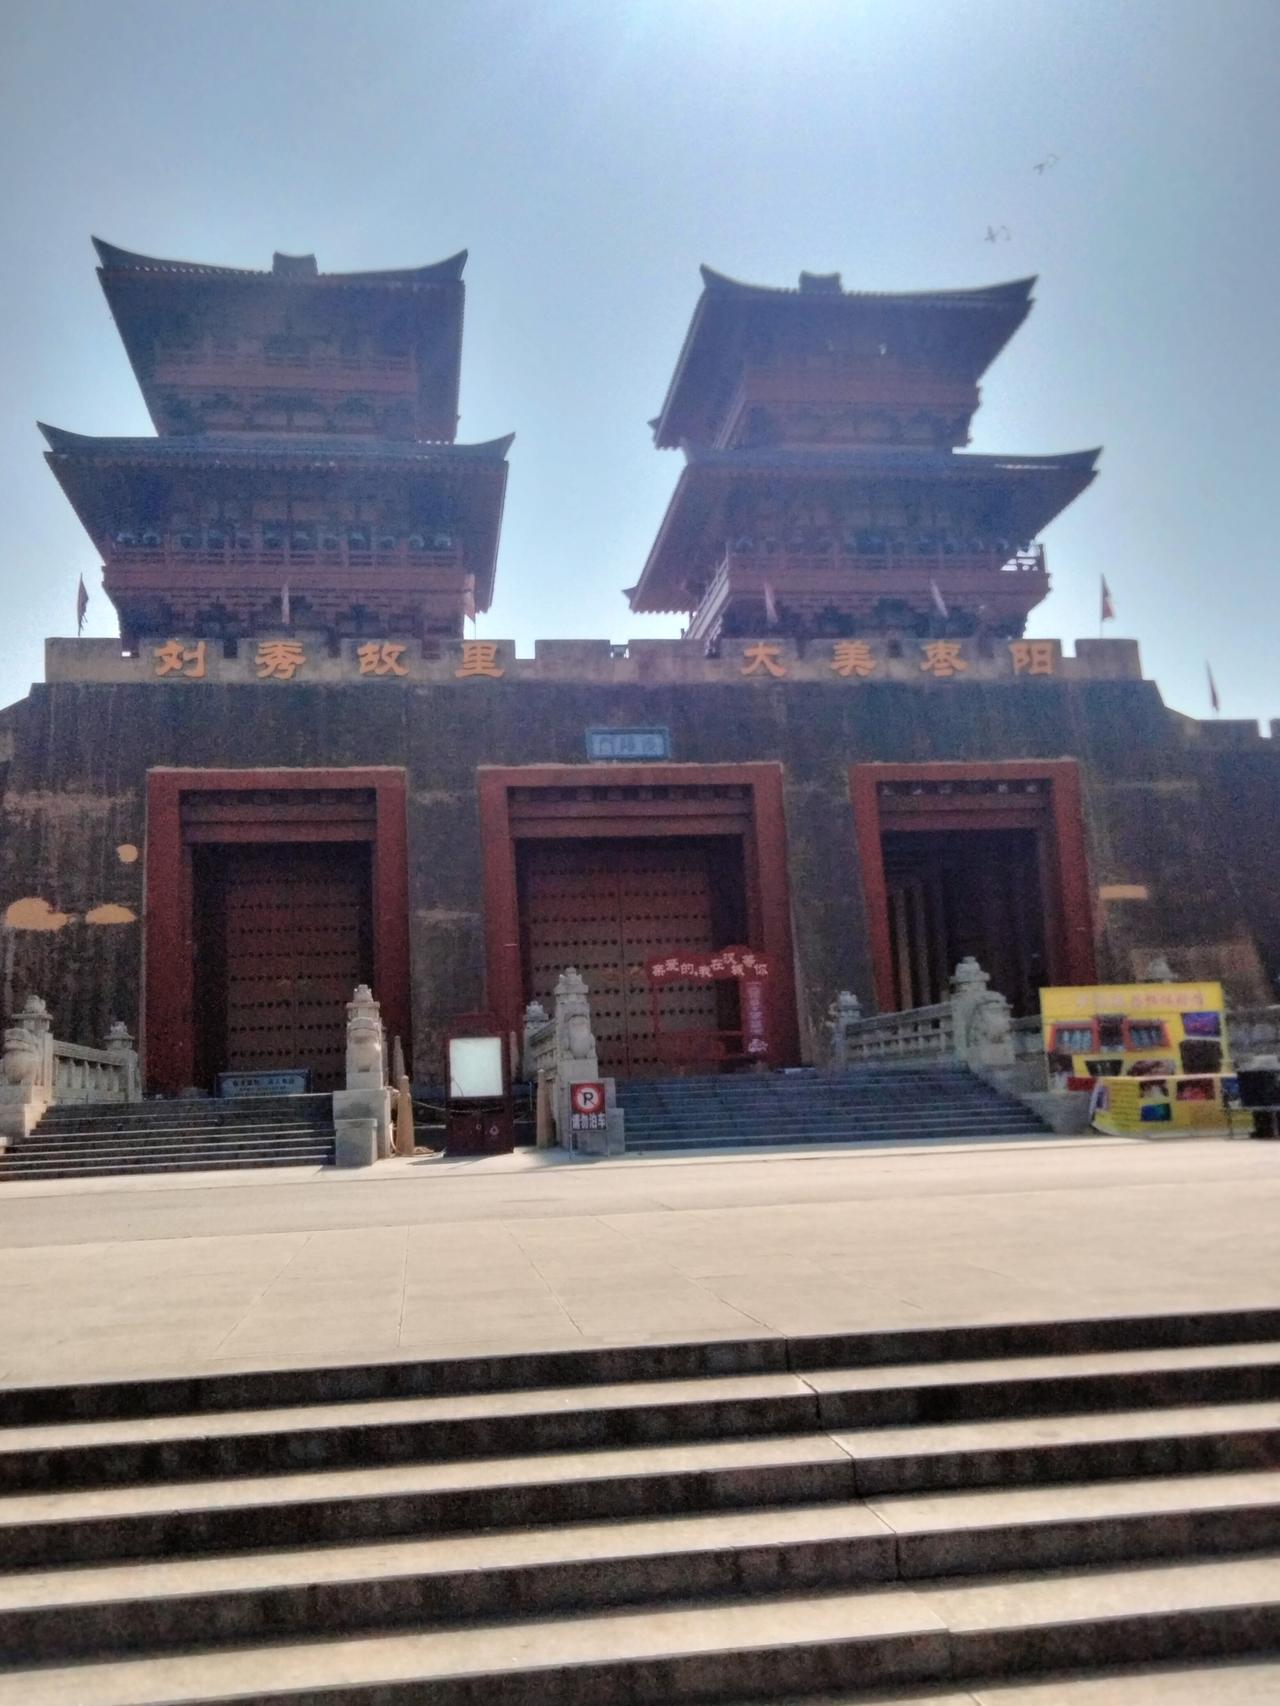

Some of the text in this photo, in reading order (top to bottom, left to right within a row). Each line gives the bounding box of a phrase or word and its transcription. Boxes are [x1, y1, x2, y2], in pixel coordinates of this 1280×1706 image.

[154, 640, 506, 680] 刘秀故里
[741, 640, 1055, 678] 大美枣阳
[572, 1113, 606, 1130] 请勿泊车
